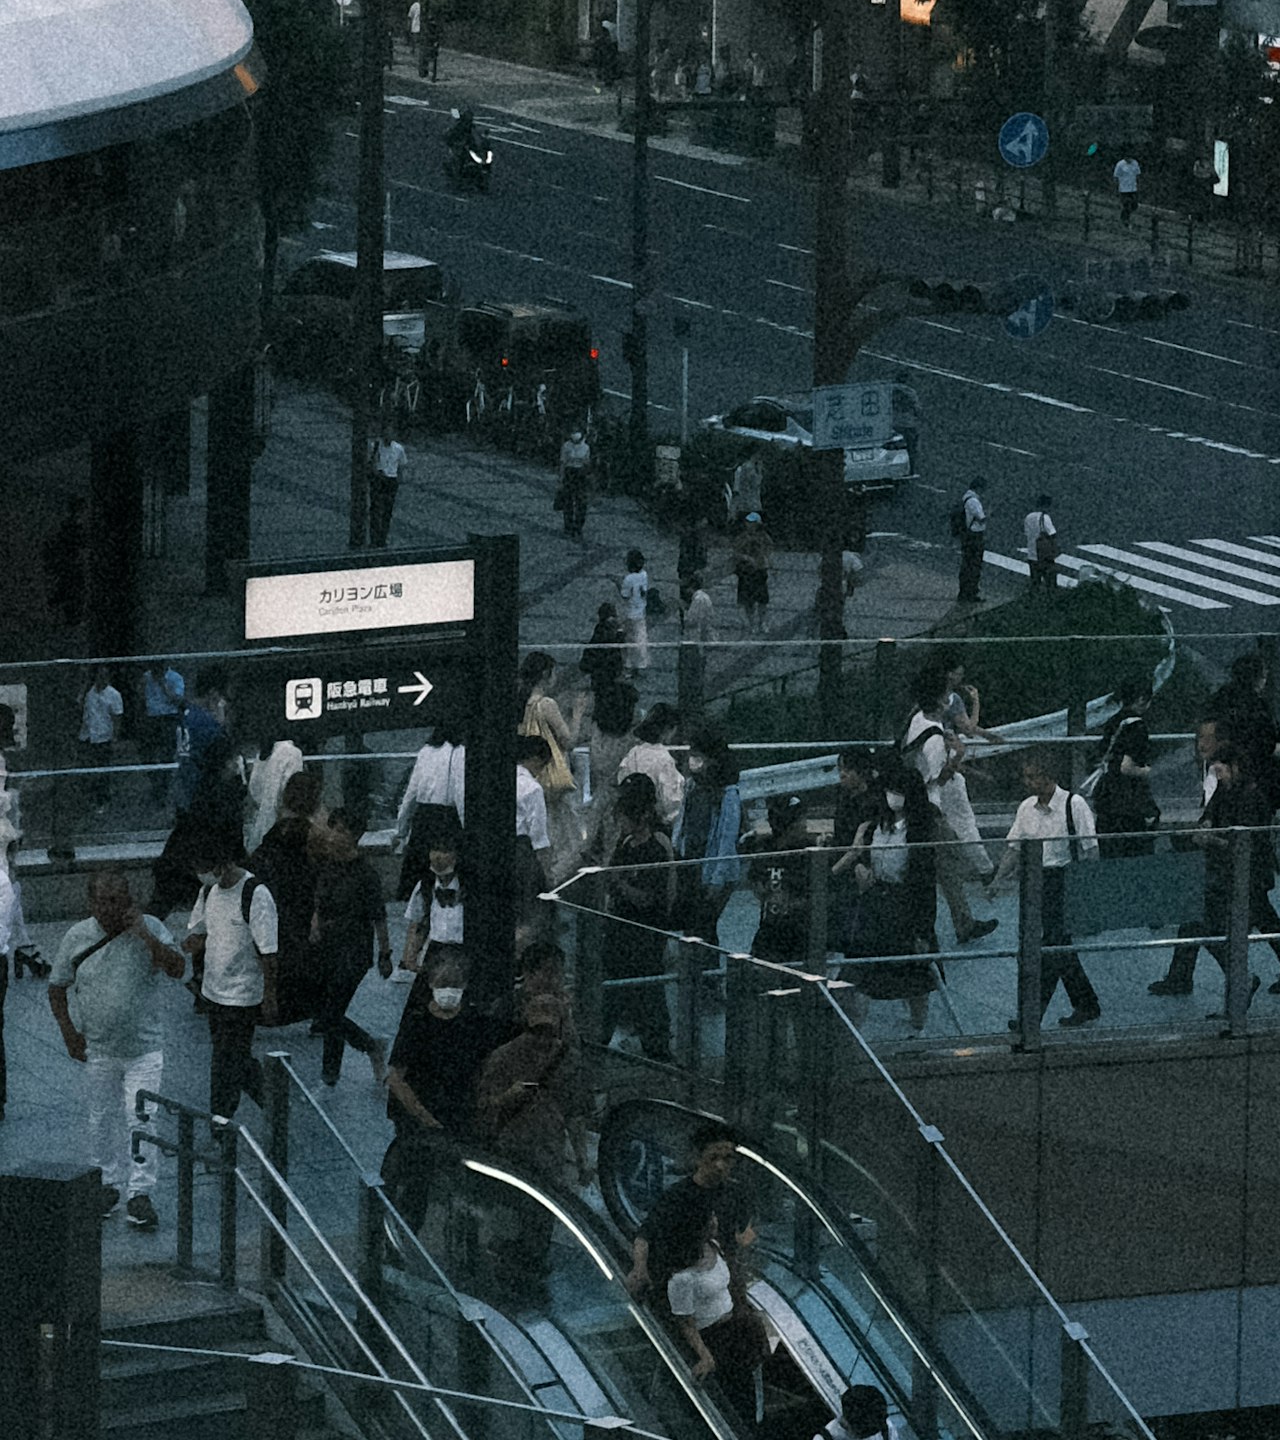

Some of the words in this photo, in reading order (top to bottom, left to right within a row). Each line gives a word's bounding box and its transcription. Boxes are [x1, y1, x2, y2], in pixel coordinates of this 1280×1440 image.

[319, 582, 404, 604] カリヨン広場
[326, 677, 389, 700] 阪急電車
